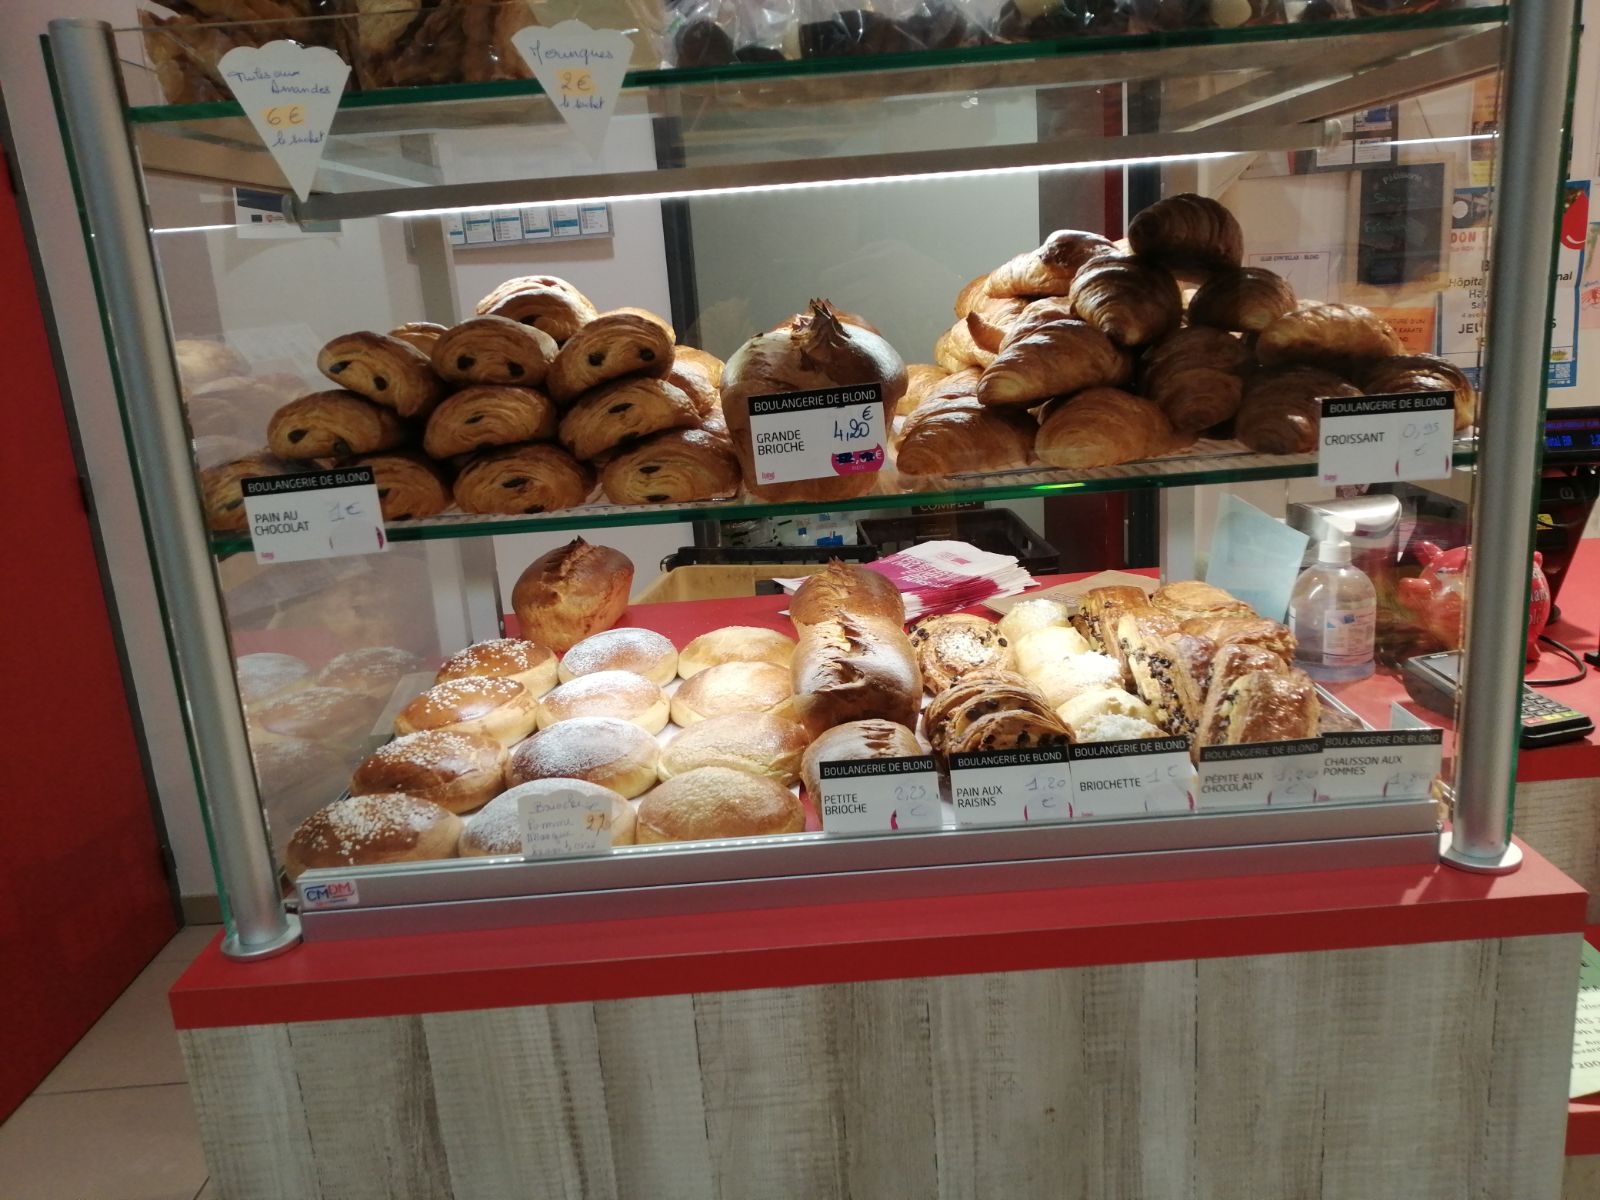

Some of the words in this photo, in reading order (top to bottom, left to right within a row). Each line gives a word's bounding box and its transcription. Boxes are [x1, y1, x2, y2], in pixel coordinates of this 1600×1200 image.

[1450, 232, 1477, 243] DON
[754, 394, 824, 412] BOULANGERIE
[827, 393, 840, 404] DE
[843, 390, 876, 402] BLOND
[1330, 399, 1397, 413] BOULANGERIE
[1400, 398, 1413, 408] DE
[1414, 397, 1447, 407] BLOND
[756, 429, 801, 443] GRANDE
[1325, 432, 1385, 446] CROISSANT
[758, 441, 805, 455] BRIOCHE
[248, 477, 317, 493] BOULANGERIE
[320, 474, 334, 486] DE
[337, 472, 370, 484] BLOND
[255, 512, 281, 524] PAIN
[283, 510, 298, 521] AU
[255, 521, 310, 536] CHOCOLAT
[1325, 736, 1391, 746] BOULANGERIE
[1393, 735, 1406, 744] DE
[1408, 734, 1439, 744] BLOND
[1075, 744, 1138, 758] BOULANGERIE
[1140, 742, 1153, 752] DE
[1155, 740, 1186, 751] BLOND
[1205, 747, 1271, 760] BOULANGERIE
[1272, 745, 1284, 755] DE
[1287, 743, 1318, 754] BLOND
[958, 754, 1017, 767] BOULANGERIE
[1019, 753, 1031, 763] DE
[1033, 751, 1062, 761] BLOND
[1325, 756, 1380, 767] CHAUSSON
[1382, 756, 1402, 764] AUX
[824, 763, 886, 777] BOULANGERIE
[889, 762, 901, 772] DE
[903, 760, 933, 771] BLOND
[1323, 767, 1366, 776] POMMES
[1080, 777, 1142, 792] BRIOCHETTE
[1205, 772, 1239, 784] PÉPITE
[1242, 772, 1264, 781] AUX
[956, 787, 980, 797] PAIN
[982, 785, 1003, 796] AUX
[1201, 782, 1253, 794] CHOCOLAT
[824, 793, 858, 804] PETITE
[957, 797, 996, 808] RAISINS
[825, 803, 867, 816] BRIOCHE
